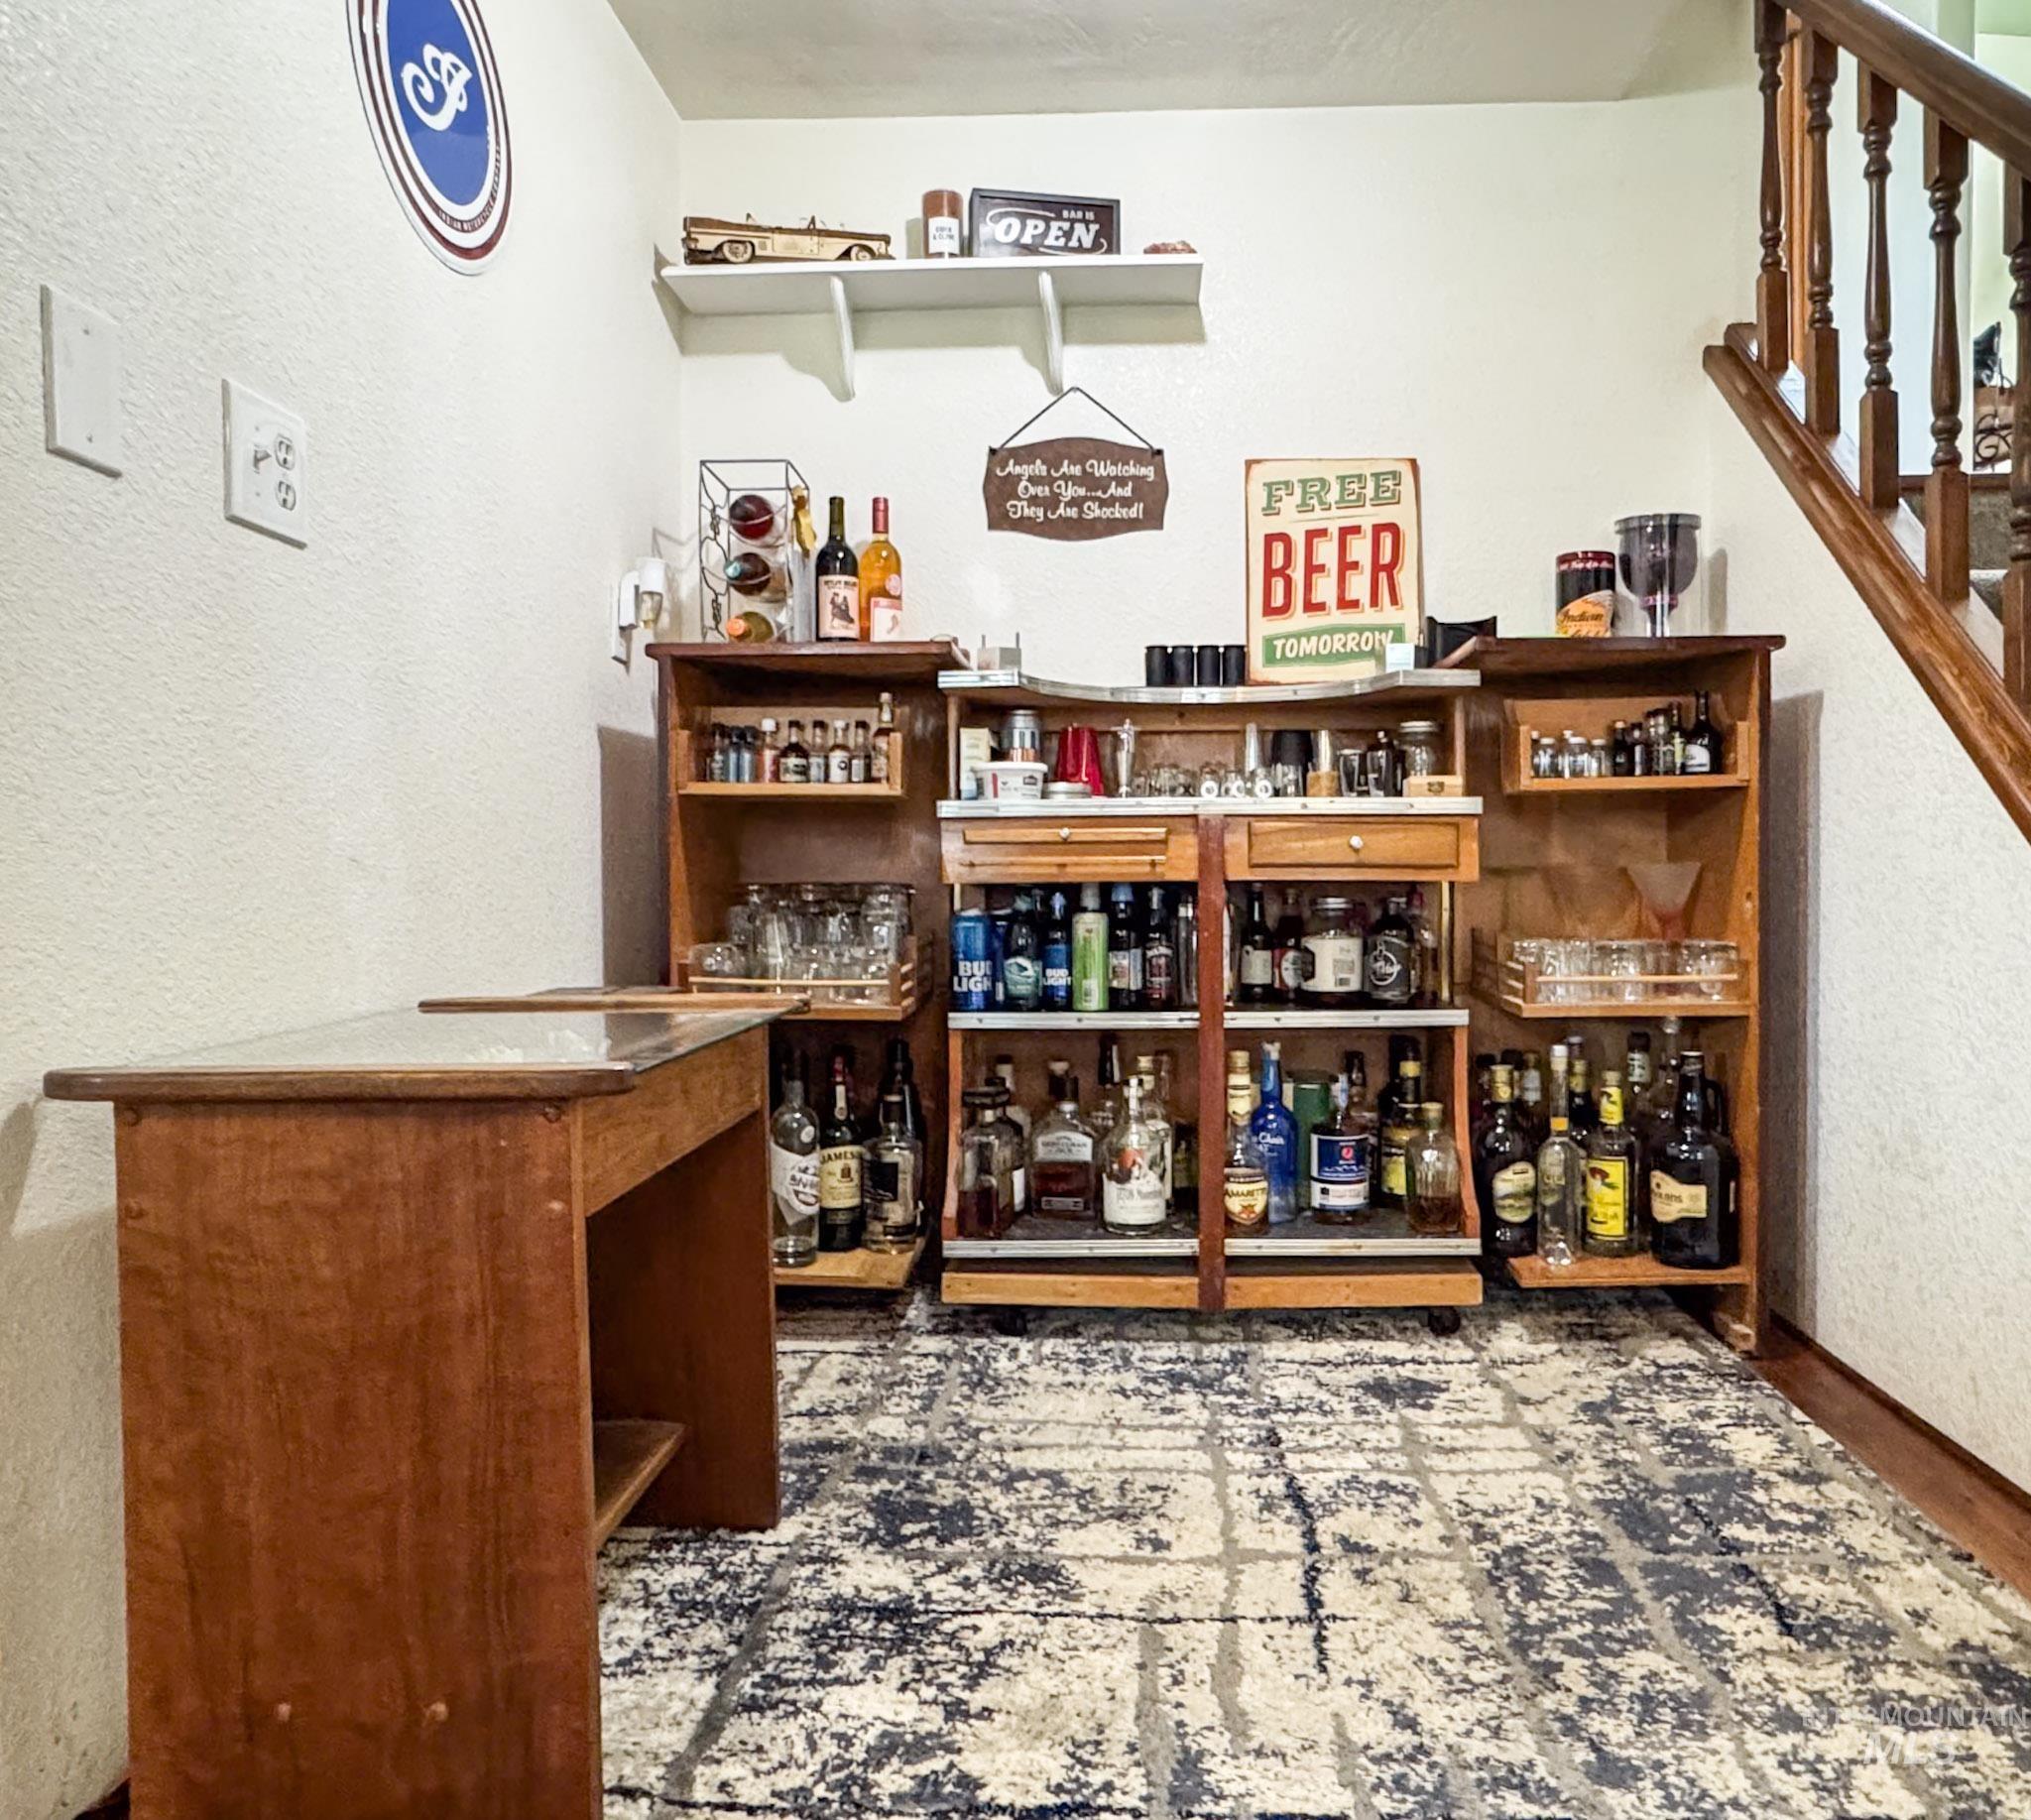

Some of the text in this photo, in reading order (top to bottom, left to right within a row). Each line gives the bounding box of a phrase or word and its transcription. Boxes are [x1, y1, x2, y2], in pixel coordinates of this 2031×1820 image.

[1062, 209, 1095, 221] BAR IS
[995, 217, 1101, 250] OPEN
[996, 458, 1154, 481] Angels Are Watching
[1017, 479, 1050, 499] Over
[1260, 469, 1402, 516] FREE
[1007, 500, 1143, 522] They Are Shocked!
[1261, 521, 1405, 621] BEER
[1272, 629, 1394, 661] TOMORROW
[1045, 968, 1069, 977] BUD
[953, 976, 992, 993] LIGH
[820, 1150, 861, 1165] JAMES
